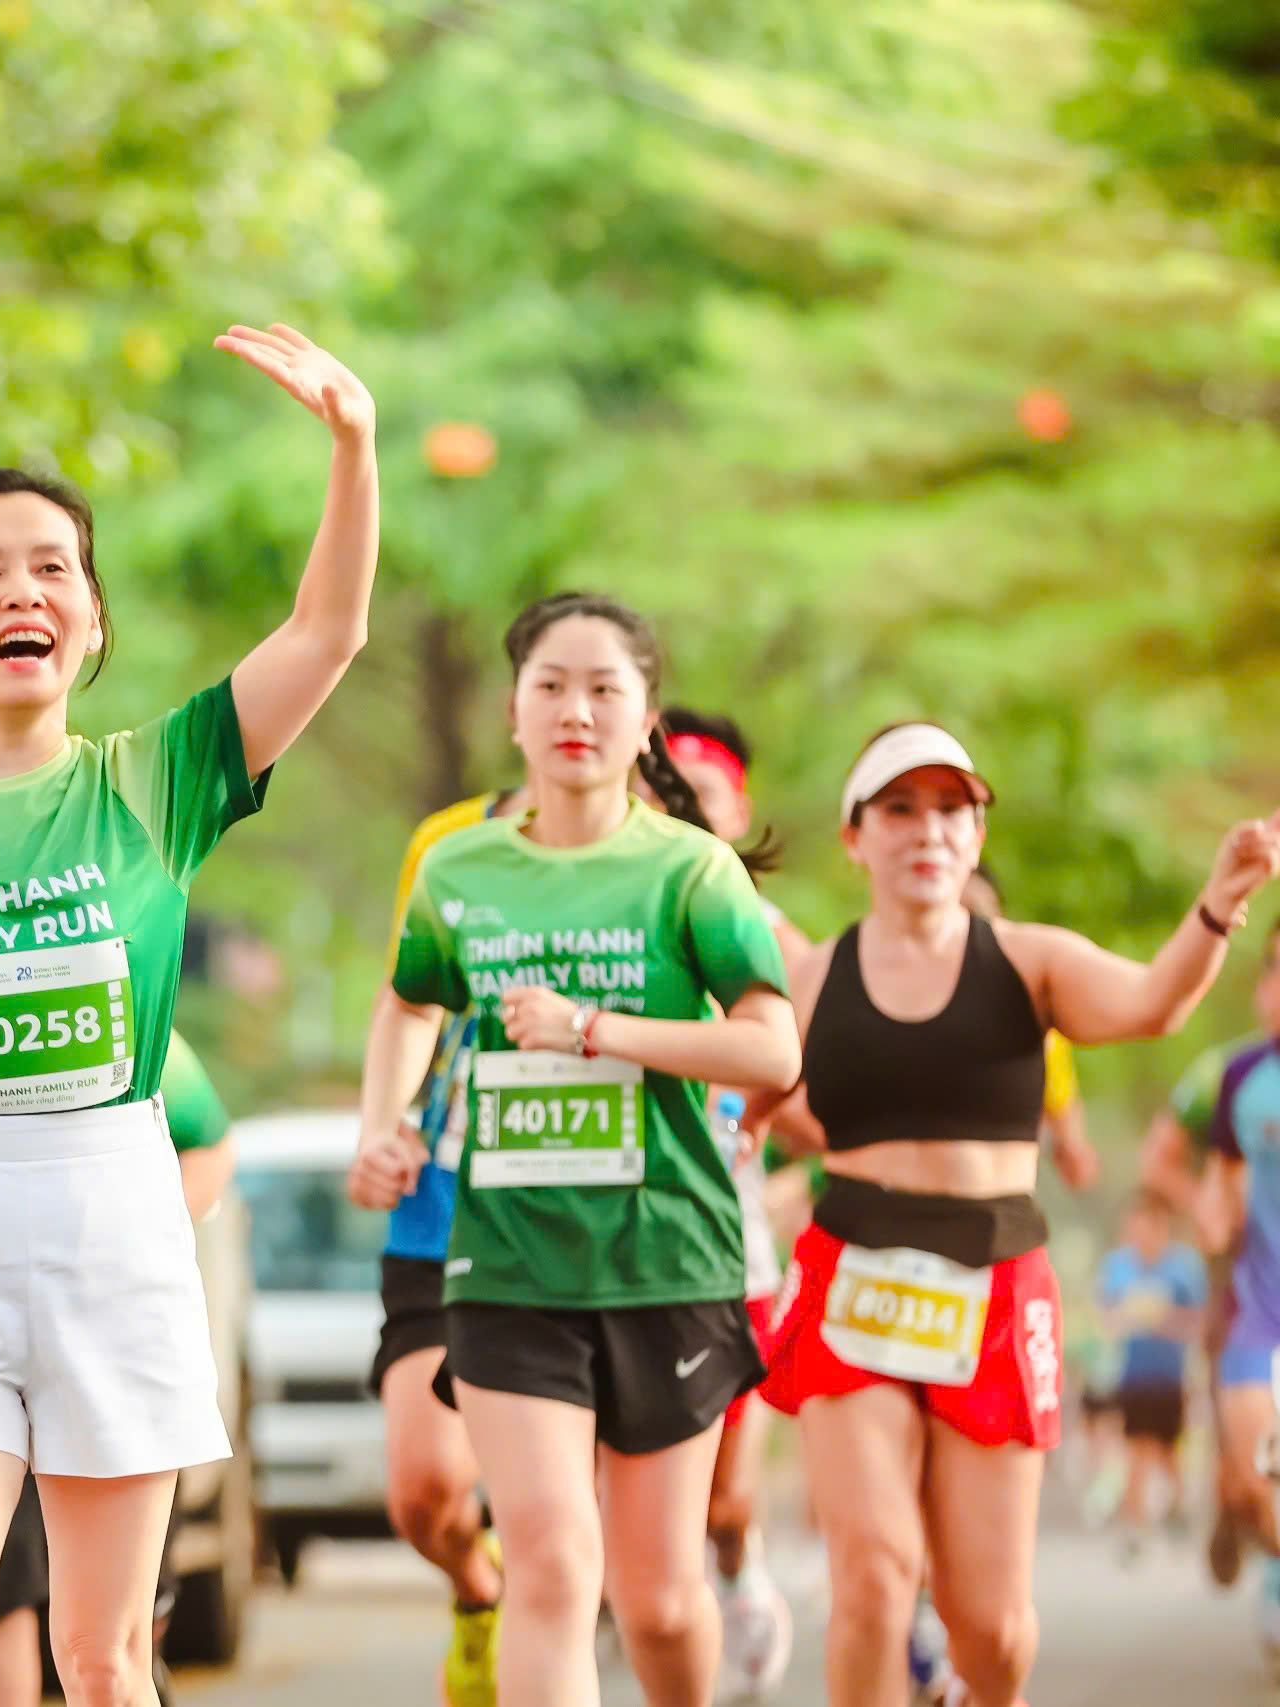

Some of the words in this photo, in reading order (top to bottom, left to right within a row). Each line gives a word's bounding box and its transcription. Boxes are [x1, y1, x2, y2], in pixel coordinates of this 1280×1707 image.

[32, 900, 114, 945] RUN
[466, 929, 545, 966] THIỆN
[552, 927, 646, 961] HẠNH
[470, 961, 573, 999] FAMILY
[577, 960, 646, 990] RUN
[0, 1087, 32, 1098] HẠNH
[35, 1082, 74, 1095] FAMILY
[77, 1077, 99, 1089] RUN
[502, 1098, 610, 1136] 40171
